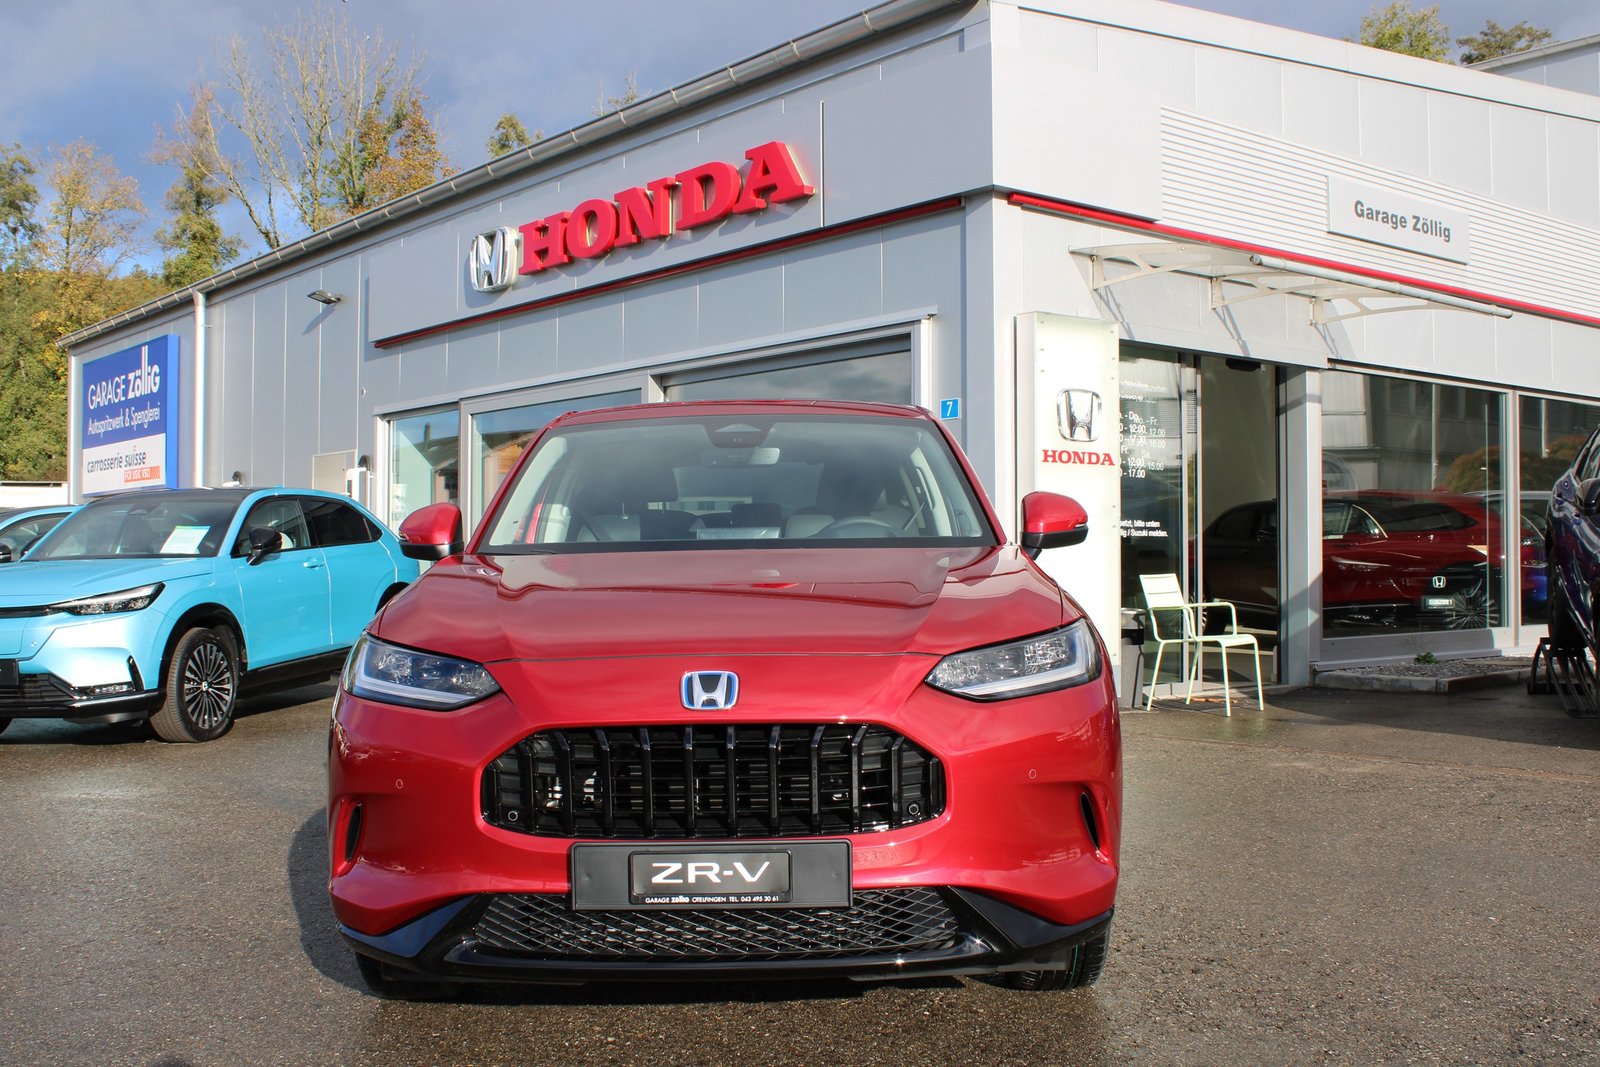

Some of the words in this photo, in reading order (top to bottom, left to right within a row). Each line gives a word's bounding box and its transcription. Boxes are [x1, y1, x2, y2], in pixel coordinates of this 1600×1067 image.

[518, 141, 816, 275] HONDA
[1354, 200, 1408, 230] Garage
[1412, 215, 1451, 243] Zöllig
[88, 375, 126, 410] GARAGE
[88, 408, 125, 438] Autospritzwerk
[125, 408, 132, 427] &
[131, 401, 160, 431] Spenglerei
[946, 401, 953, 417] 7
[87, 452, 123, 473] carrosserie
[124, 446, 147, 468] suisse
[1042, 449, 1116, 466] HONDA
[1148, 461, 1165, 470] 15.00
[1128, 468, 1146, 478] 17.00
[651, 861, 770, 883] ZR-V
